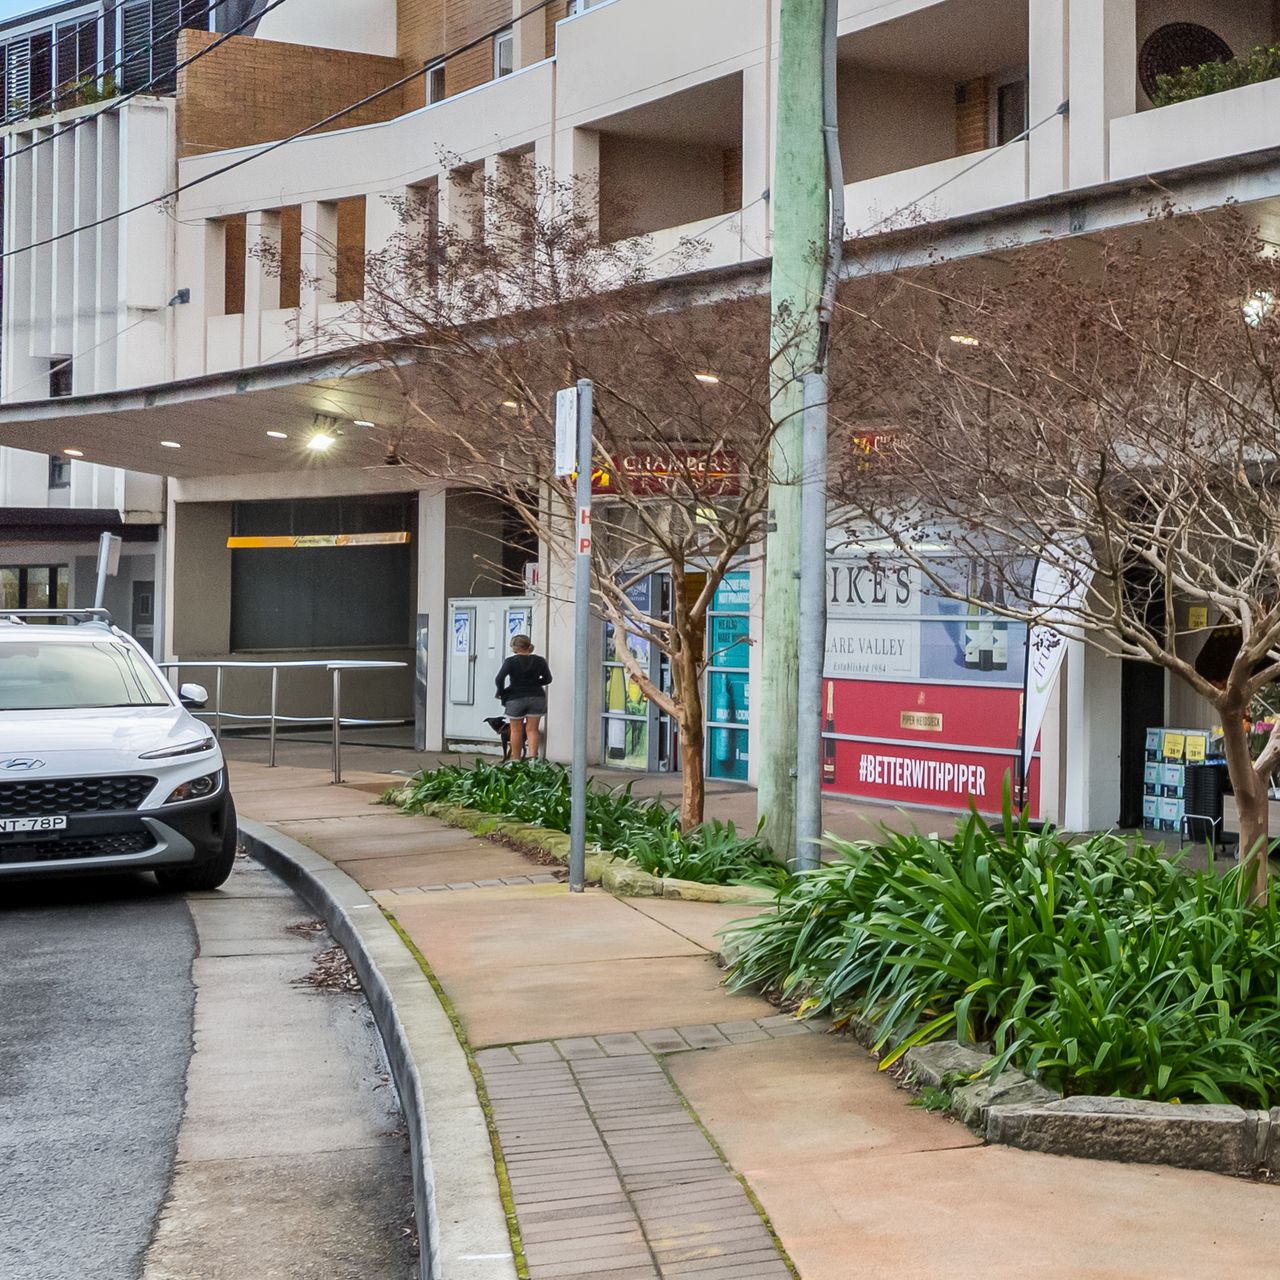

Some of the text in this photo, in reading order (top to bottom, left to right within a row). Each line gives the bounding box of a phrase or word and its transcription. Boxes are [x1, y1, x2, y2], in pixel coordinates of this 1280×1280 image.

[831, 566, 910, 604] IKES
[858, 637, 905, 656] VALLEY
[859, 753, 986, 797] #BETTERWITHPIPER
